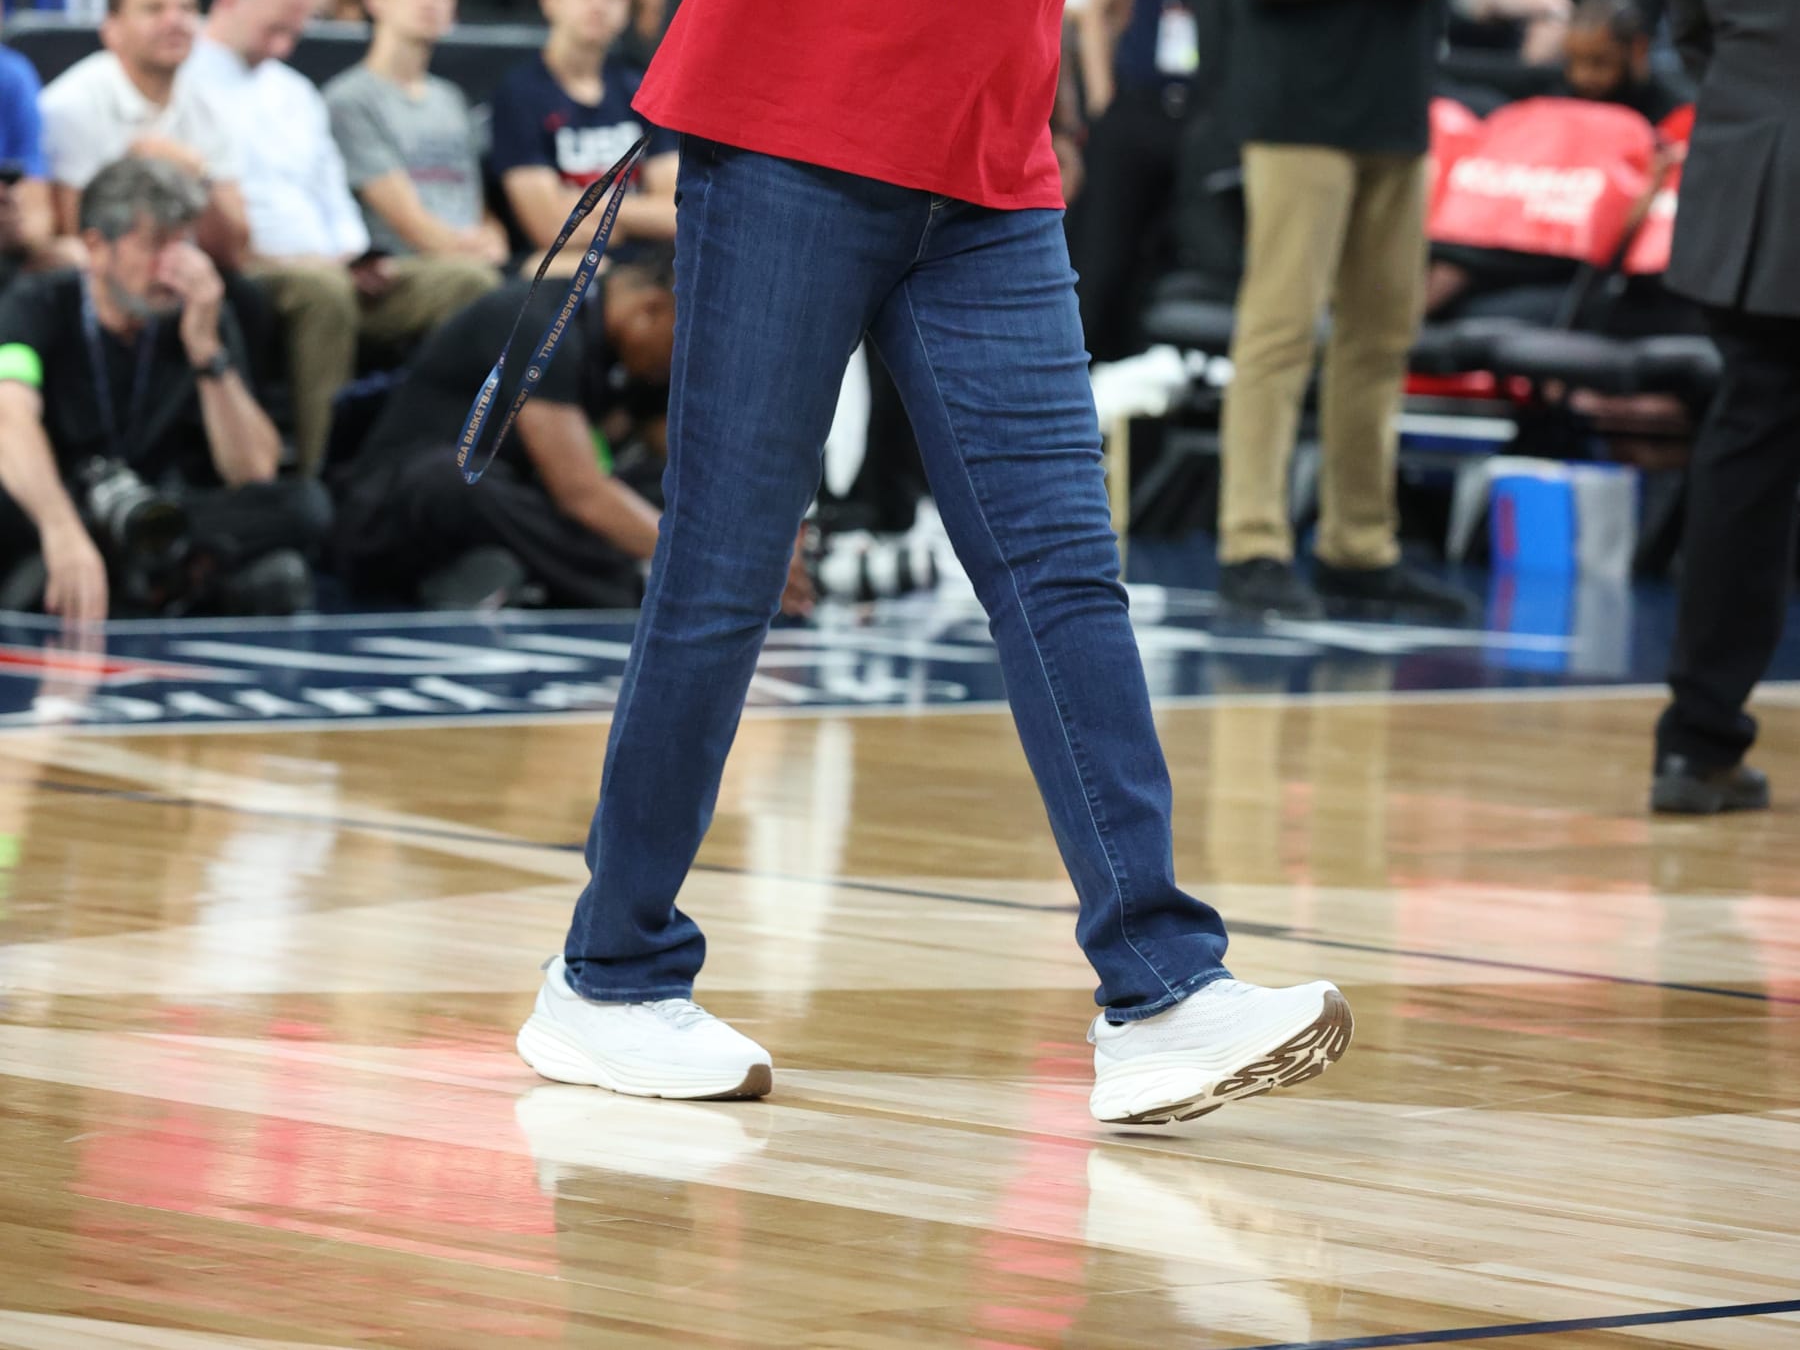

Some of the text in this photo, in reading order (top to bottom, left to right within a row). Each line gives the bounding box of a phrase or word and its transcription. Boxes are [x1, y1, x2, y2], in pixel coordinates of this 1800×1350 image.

[537, 270, 589, 359] USA BASKETBALL
[456, 377, 499, 468] USA BASKETBALL
